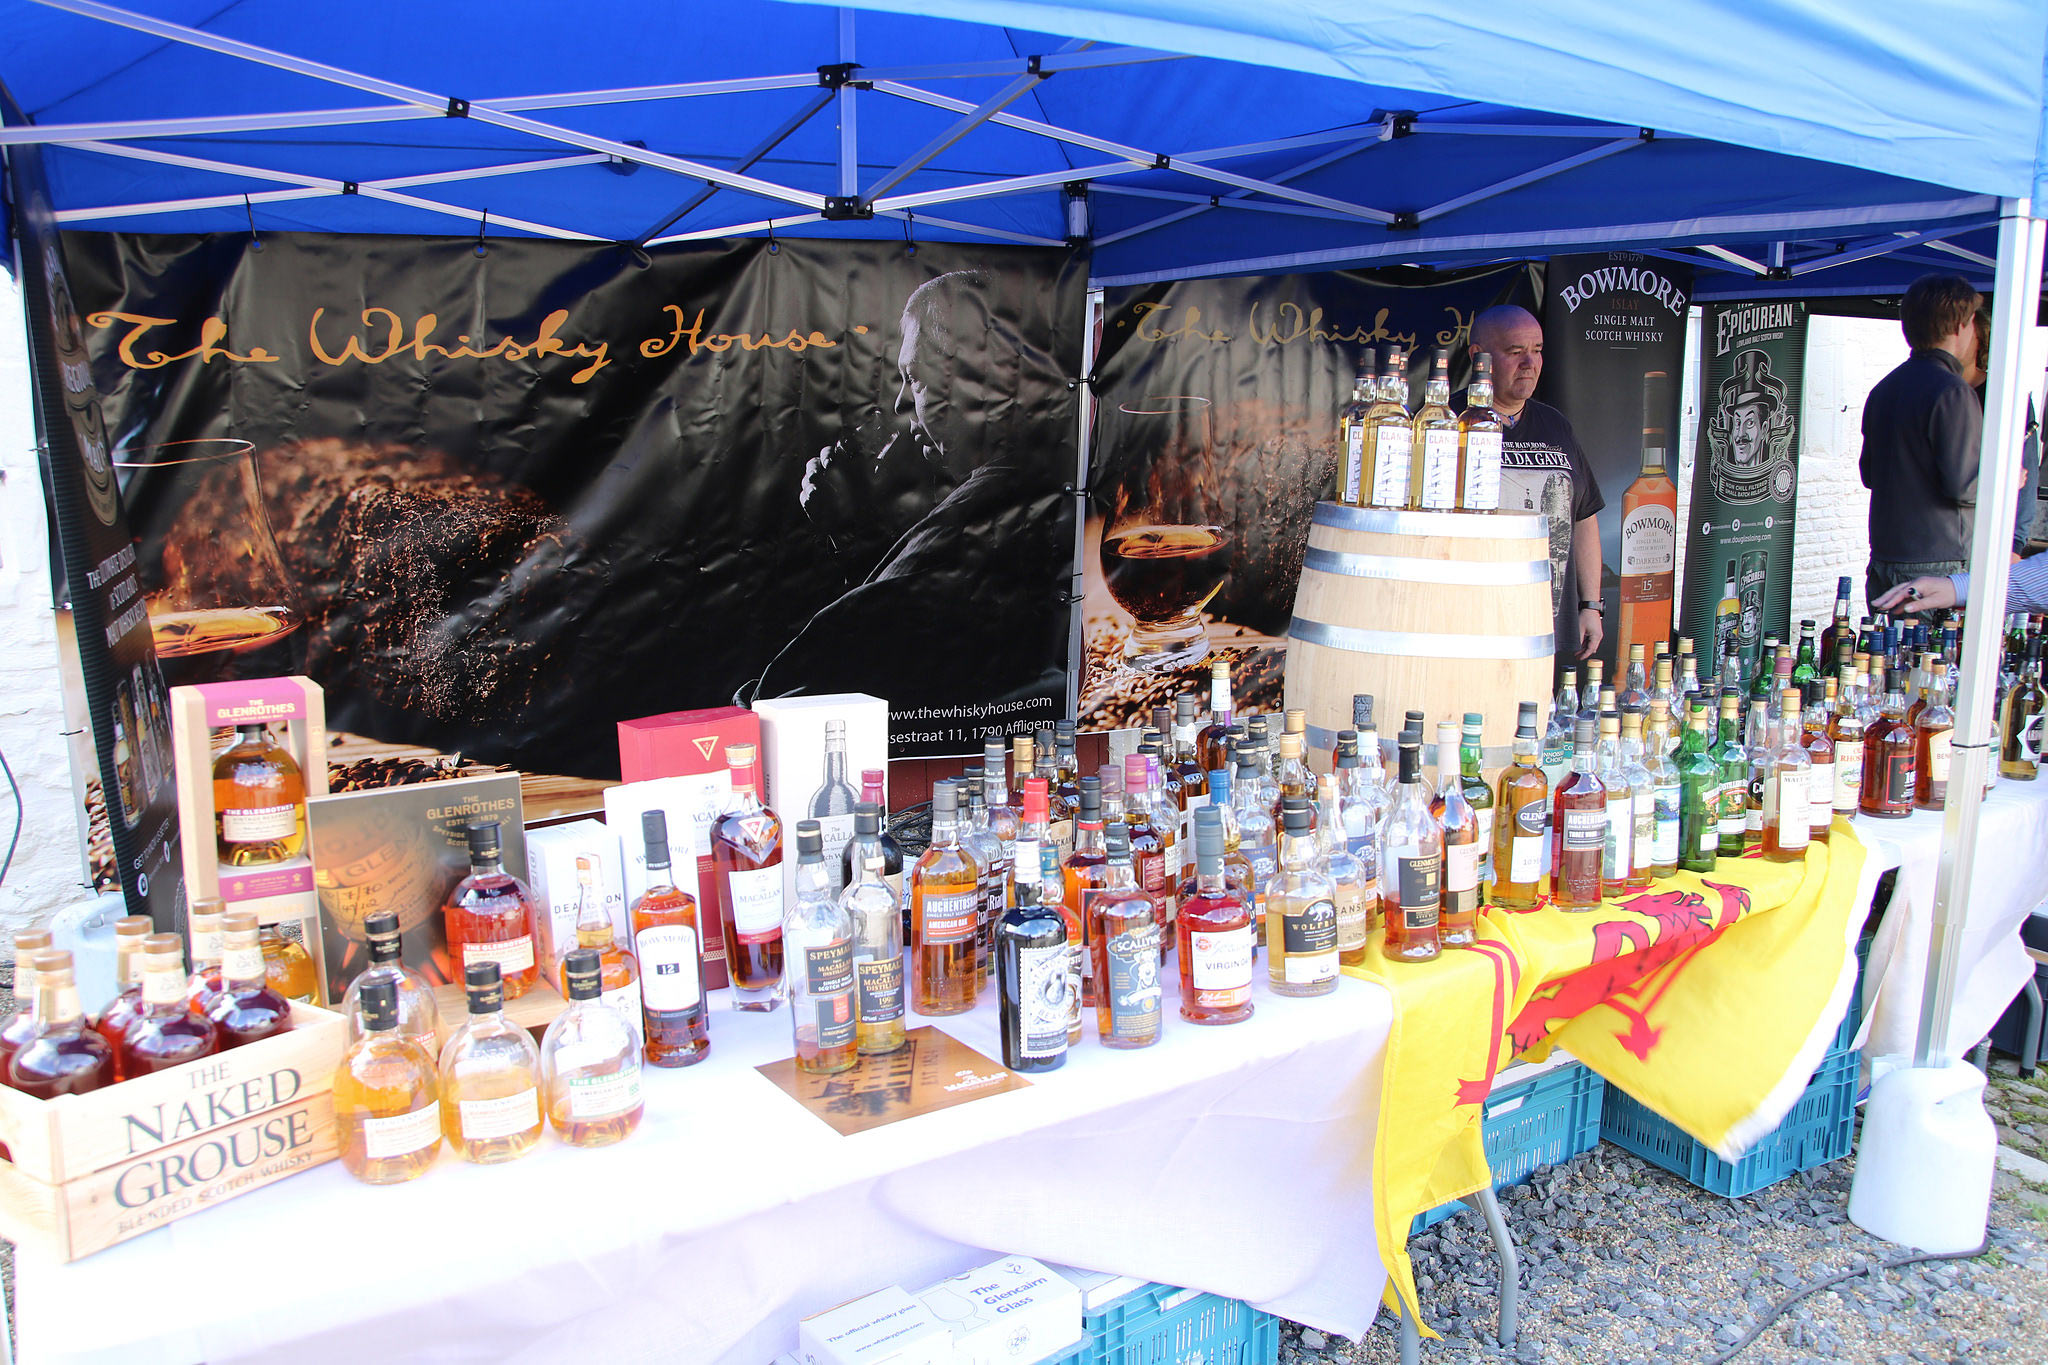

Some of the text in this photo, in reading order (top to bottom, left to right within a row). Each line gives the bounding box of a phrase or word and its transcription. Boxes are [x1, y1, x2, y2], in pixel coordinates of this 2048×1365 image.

[1559, 266, 1686, 317] BOWMORE
[1611, 298, 1640, 311] ISLAY
[1133, 302, 1232, 343] The
[1249, 300, 1420, 356] Whisky
[1594, 315, 1655, 326] SINGLE MALT
[1585, 330, 1663, 342] SCOTCH WHISKY
[1716, 304, 1793, 357] EPICUREAN
[86, 305, 838, 384] The Whisky House
[1514, 453, 1572, 468] DA GAVEA
[1725, 488, 1737, 497] SMALL
[1751, 486, 1768, 496] RELEASE
[1748, 479, 1768, 489] FILTERED
[1625, 517, 1674, 539] BOWMORE
[1643, 579, 1652, 591] 15
[248, 698, 264, 706] THE
[217, 702, 295, 719] GLENROTHES
[948, 728, 968, 742] 11,
[972, 725, 1003, 740] 1790
[1005, 718, 1055, 736] Affligem
[462, 795, 479, 804] THE
[226, 803, 294, 816] THE GLENROTHES
[426, 798, 516, 820] GLENROTHES
[739, 888, 781, 903] MACALLAN
[928, 918, 968, 929] AMERICAN OAK
[661, 964, 675, 975] 12
[1206, 960, 1240, 970] VIRGIN
[187, 1061, 231, 1089] THE
[121, 1068, 301, 1155] NAKED
[114, 1109, 314, 1209] GROUSE
[118, 1150, 314, 1234] BLENDED SCOTCH WHISKY
[969, 1282, 1000, 1296] The
[983, 1277, 1048, 1305] Glencairn
[996, 1296, 1034, 1314] Glass
[826, 1304, 917, 1343] The official whisky glass
